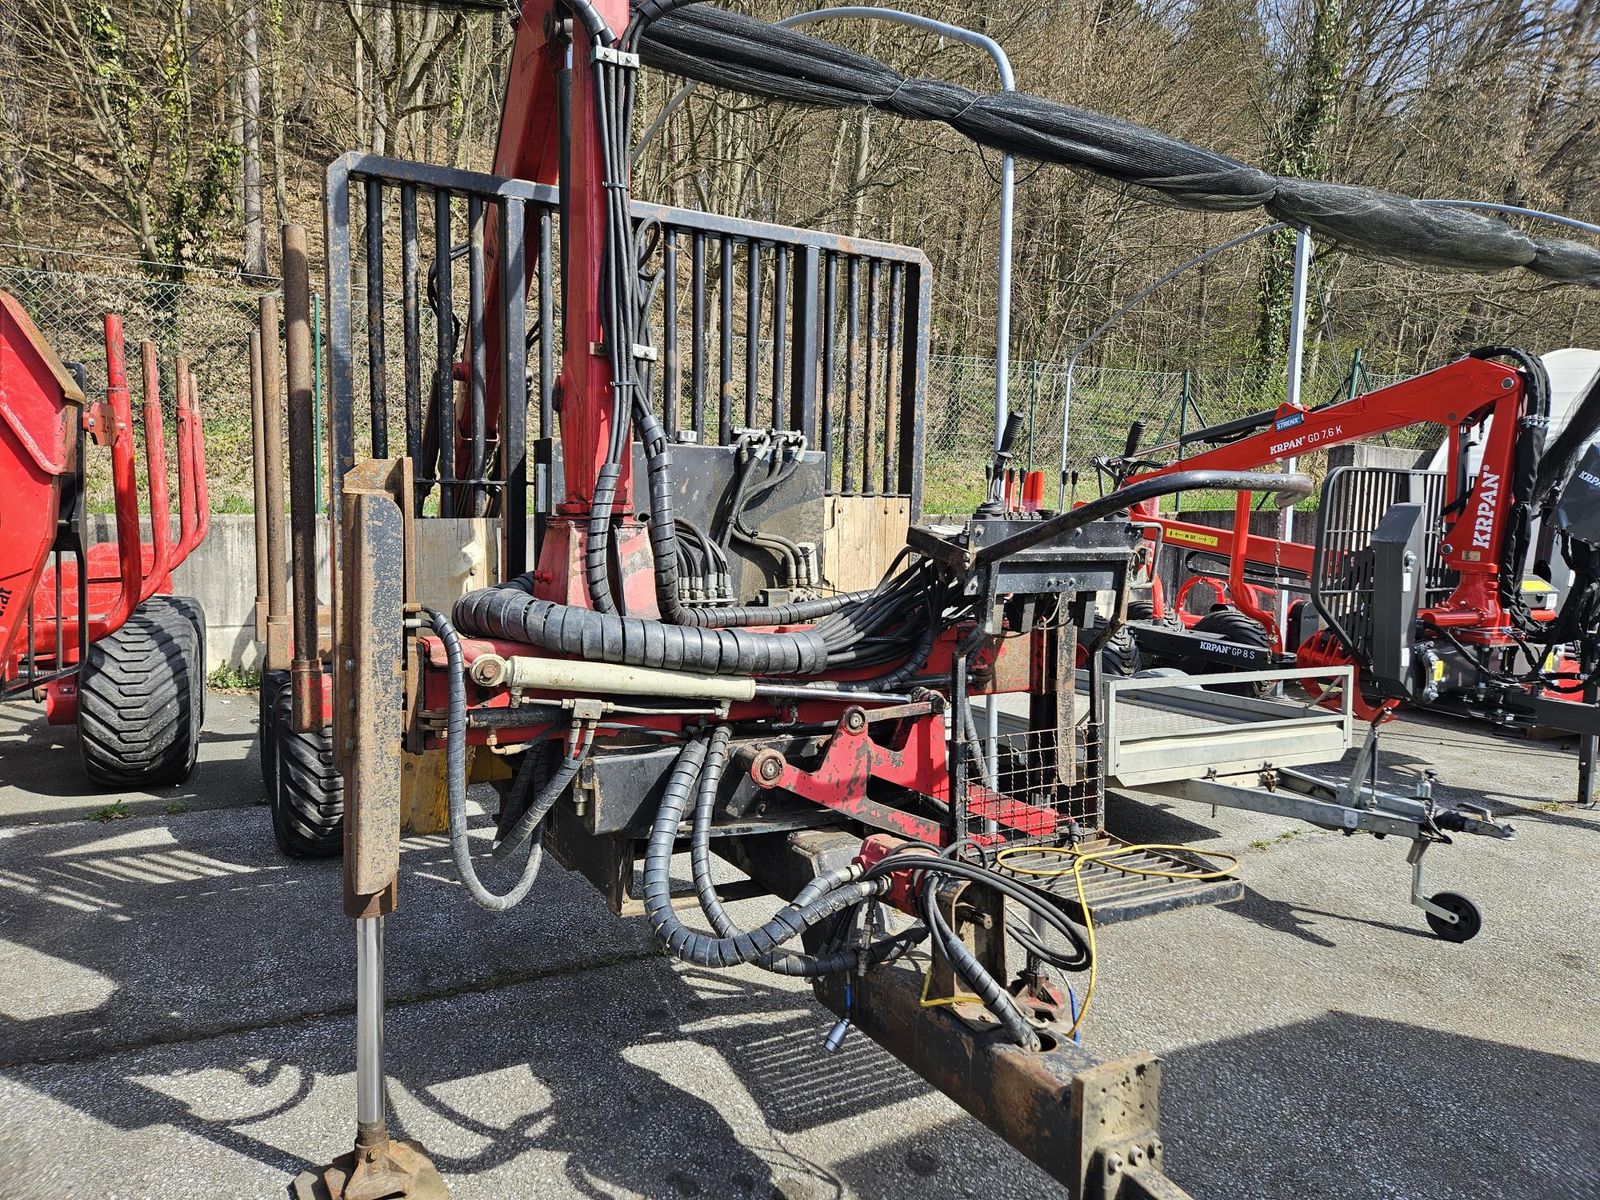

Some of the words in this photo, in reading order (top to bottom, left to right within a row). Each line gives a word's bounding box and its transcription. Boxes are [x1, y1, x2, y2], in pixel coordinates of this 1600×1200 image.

[1308, 432, 1320, 443] GD
[1336, 424, 1343, 435] K
[1231, 647, 1242, 656] GP
[1243, 650, 1248, 658] 8
[1250, 651, 1255, 660] S
